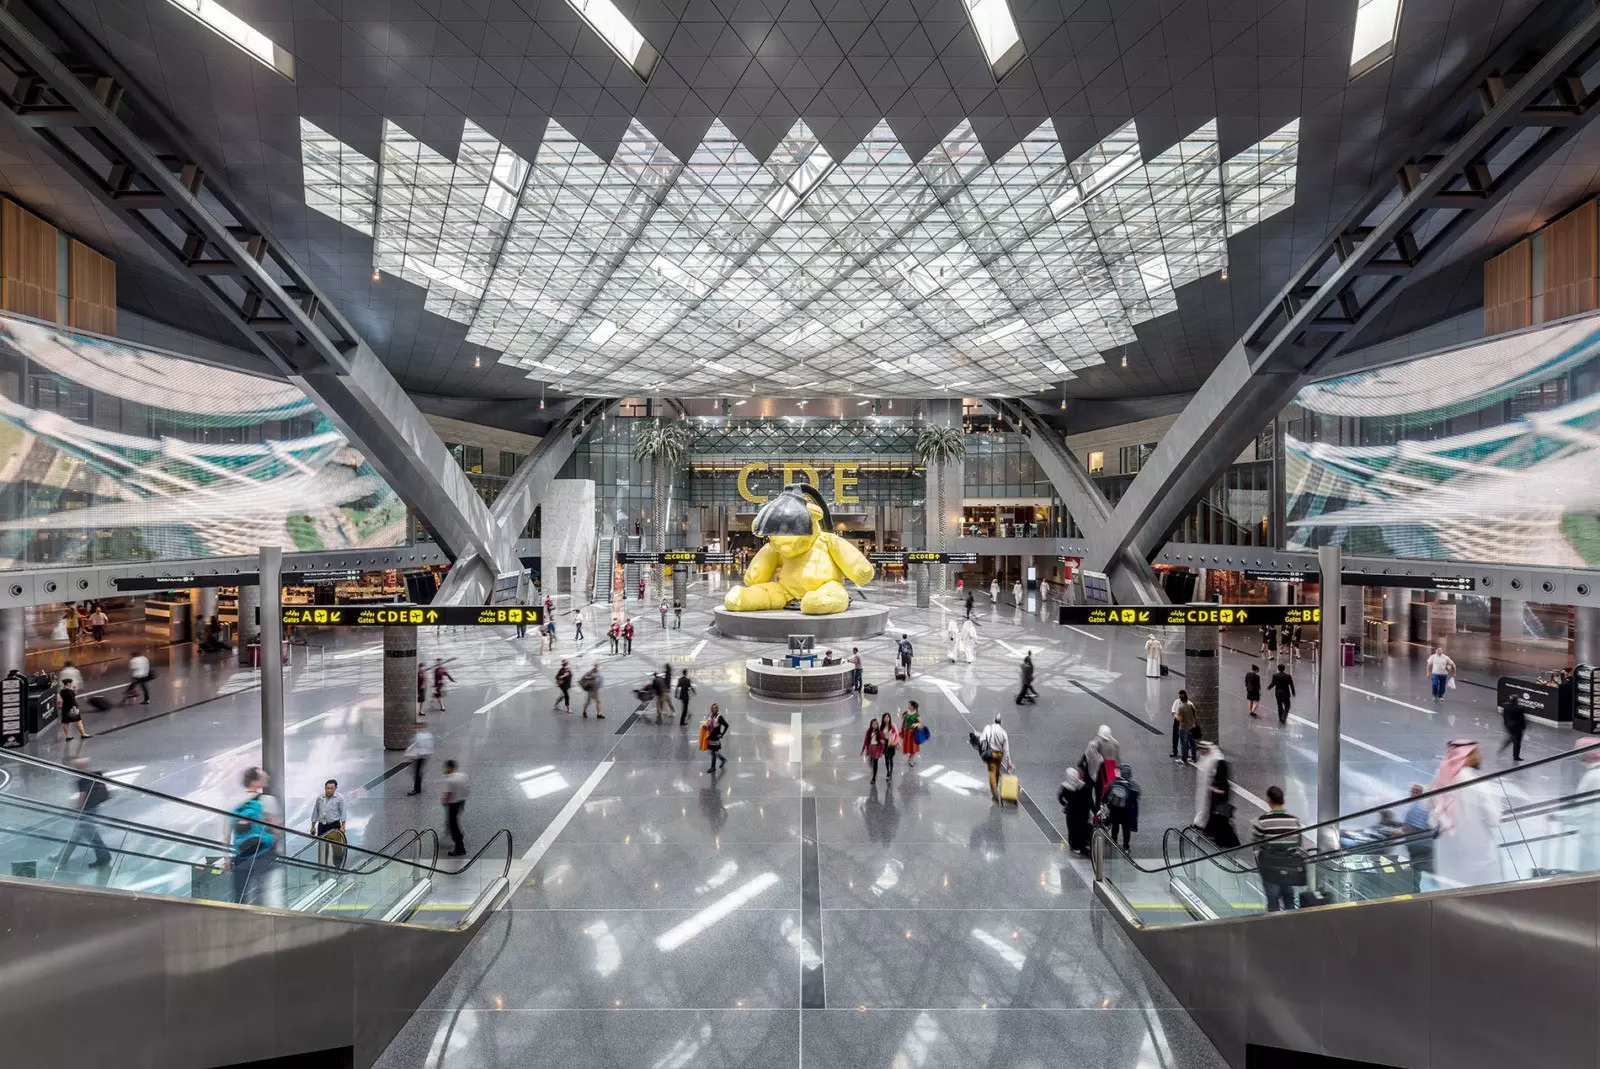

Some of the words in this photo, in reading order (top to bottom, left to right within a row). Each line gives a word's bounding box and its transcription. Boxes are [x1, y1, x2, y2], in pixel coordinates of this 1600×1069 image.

[302, 611, 312, 622] A
[498, 610, 507, 621] B
[1108, 611, 1119, 621] A
[1303, 610, 1312, 621] B
